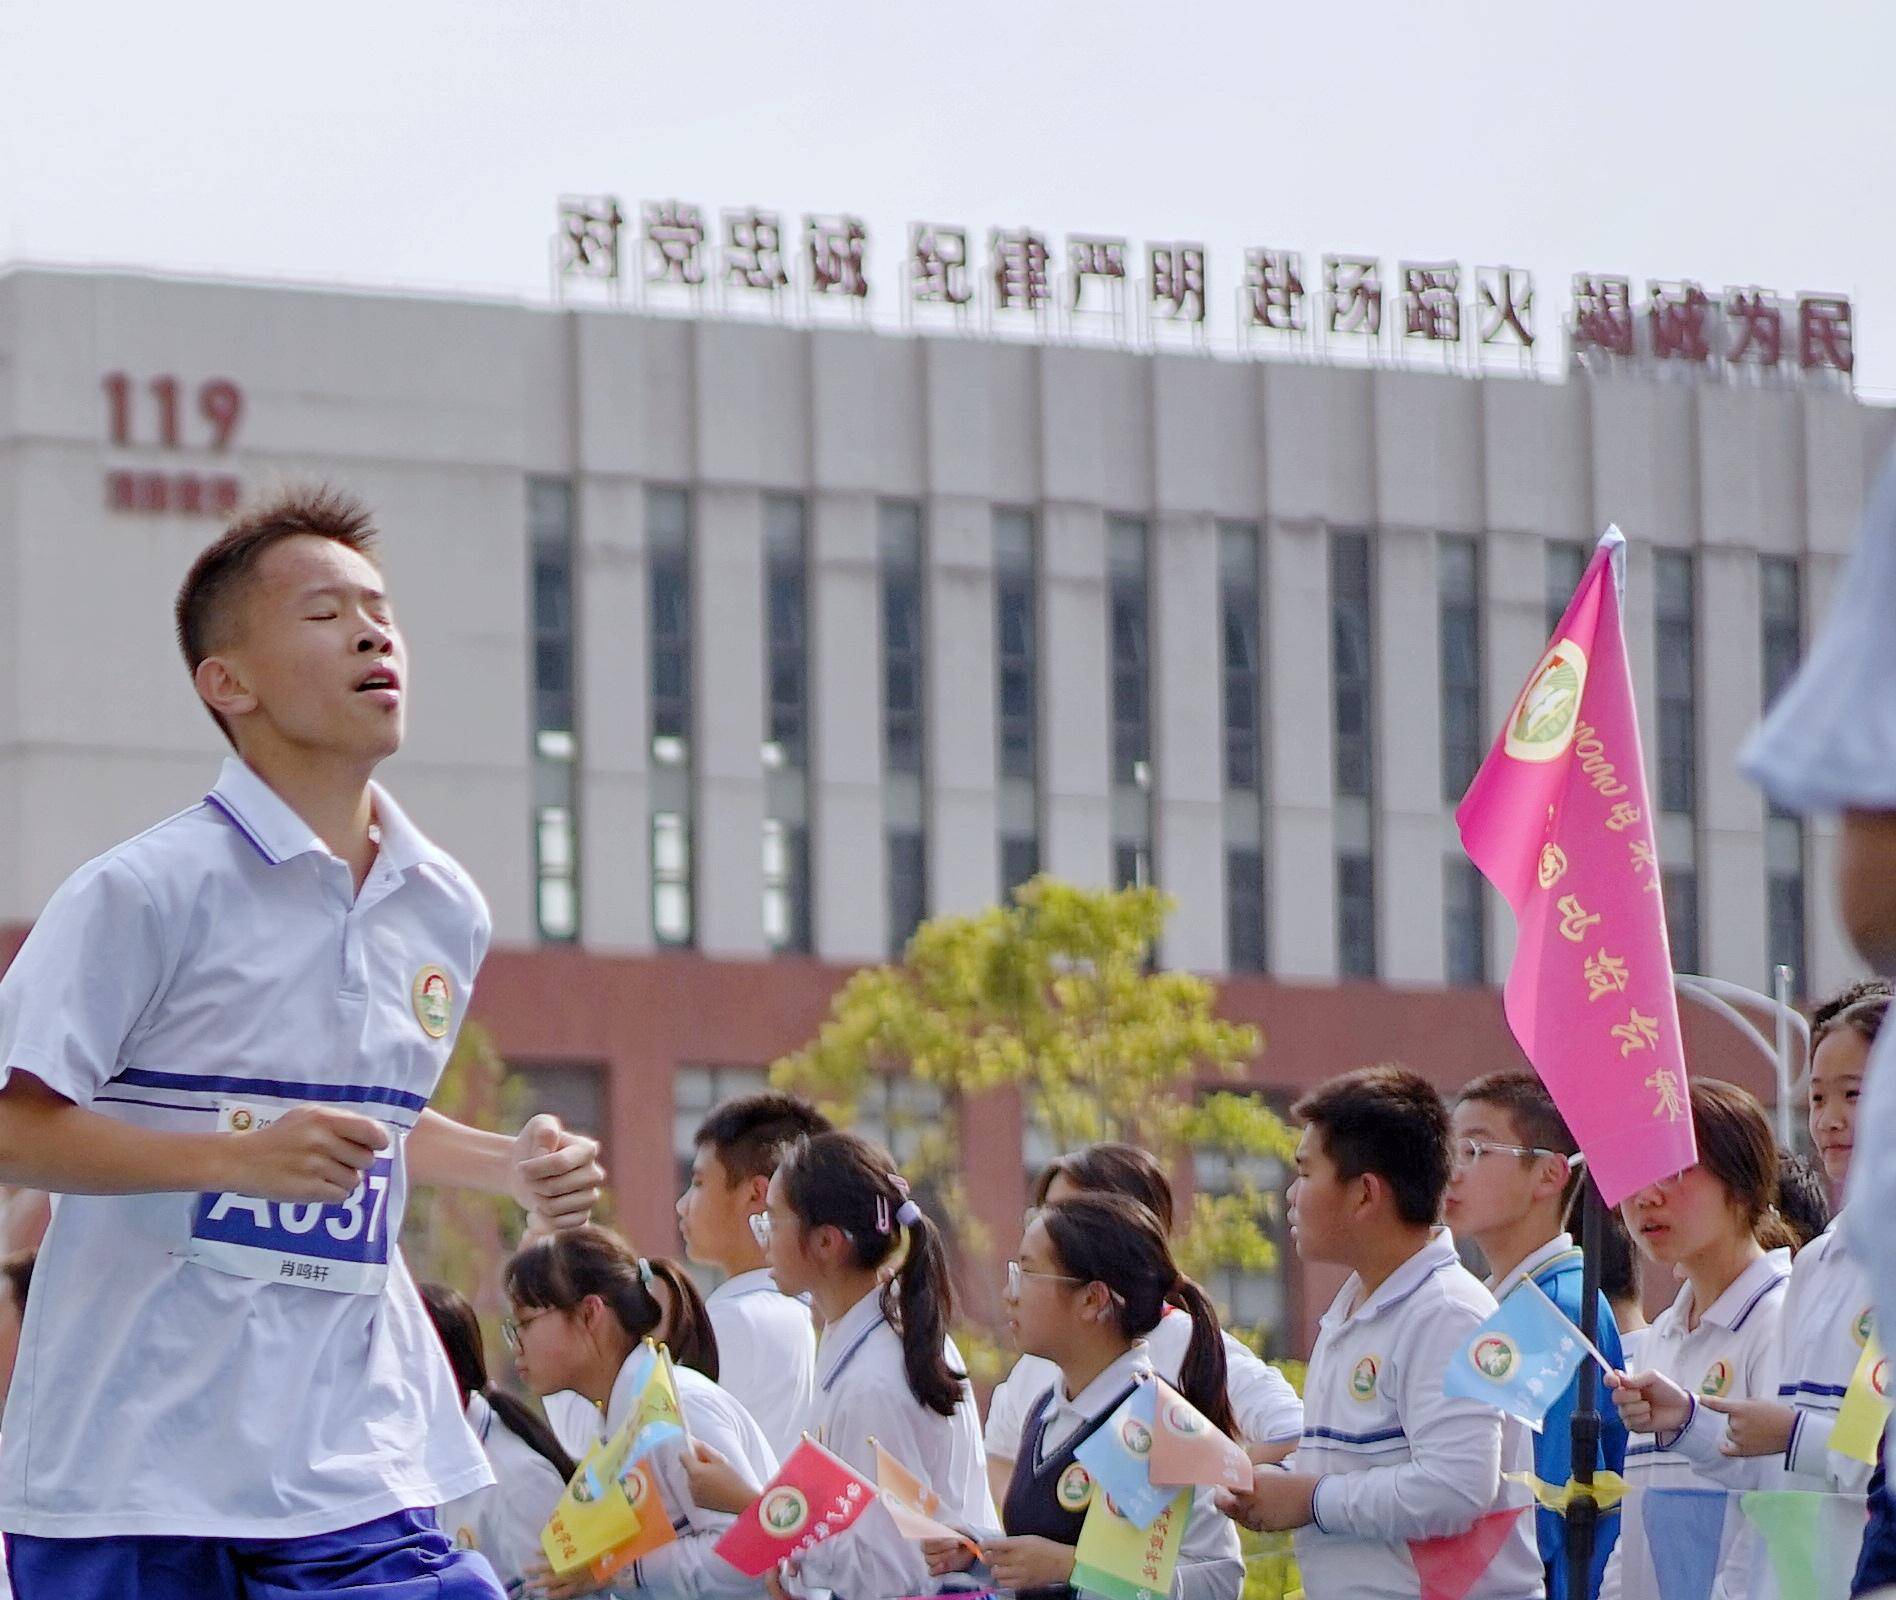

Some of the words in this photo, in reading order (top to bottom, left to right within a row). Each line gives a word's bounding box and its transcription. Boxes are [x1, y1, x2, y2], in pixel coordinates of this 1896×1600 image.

[558, 195, 869, 298] 对党忠诚
[908, 220, 1207, 322] 纪律严明
[1243, 247, 1535, 346] 赴汤蹈火
[101, 371, 244, 453] 119
